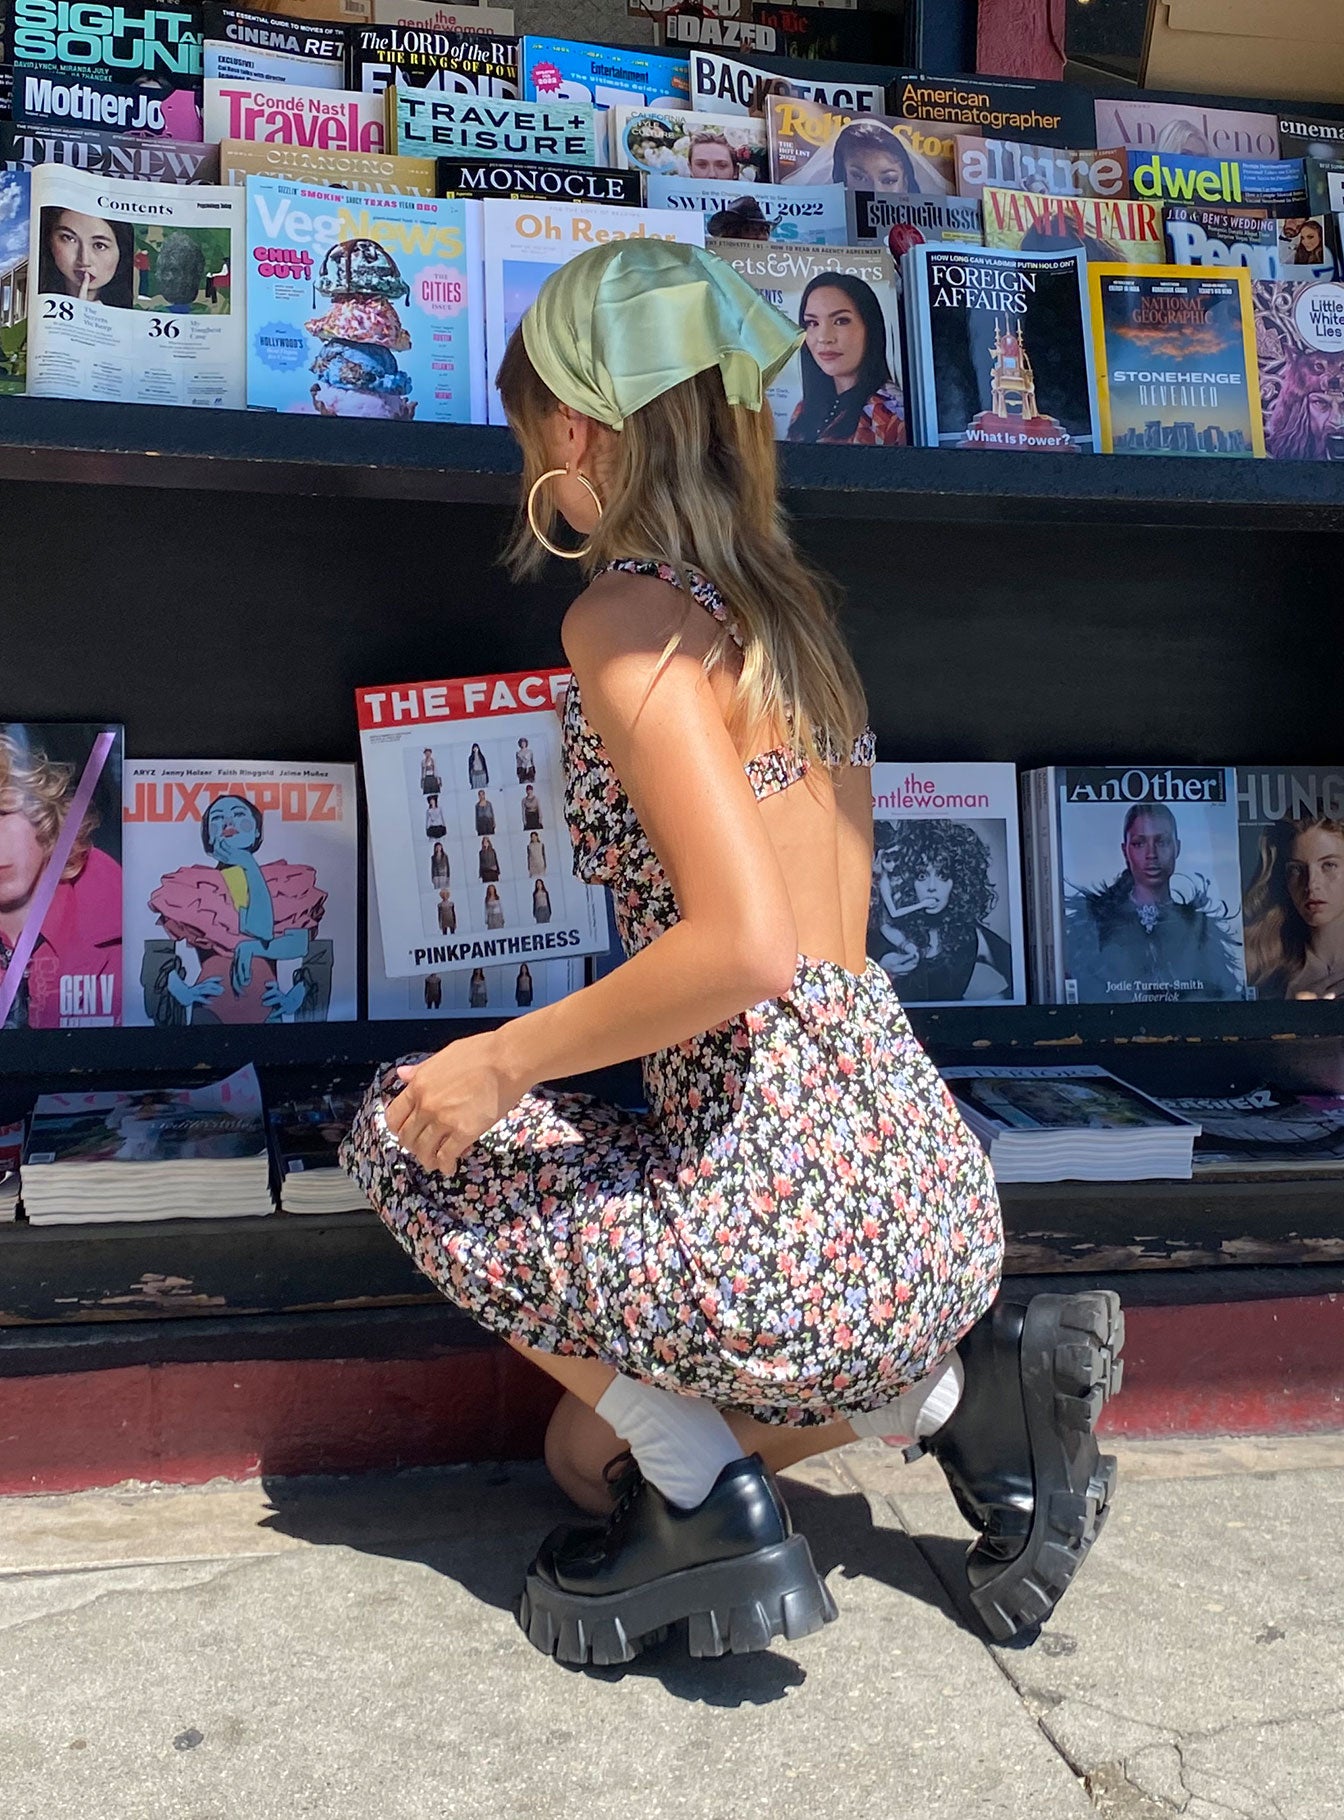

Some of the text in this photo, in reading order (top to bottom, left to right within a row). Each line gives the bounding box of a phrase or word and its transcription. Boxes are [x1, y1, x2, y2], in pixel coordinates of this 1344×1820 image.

[14, 0, 192, 42] SIGHT
[223, 9, 235, 17] THE
[236, 12, 269, 24] ESSENTIAL
[270, 18, 290, 28] GUIDE
[290, 22, 300, 30] TO
[300, 25, 324, 34] MOVIES
[435, 10, 456, 25] the
[678, 15, 776, 52] DAZED
[360, 32, 389, 50] The
[391, 29, 450, 56] LORD
[451, 43, 468, 62] of
[468, 44, 490, 62] the
[377, 50, 405, 64] THE
[410, 53, 458, 70] RINGS
[463, 60, 479, 73] OF
[591, 61, 649, 84] Entertainment
[25, 76, 133, 126] Mother
[253, 92, 346, 117] Condé Nast
[902, 84, 990, 107] American
[631, 111, 687, 123] CALIFORNIA
[902, 100, 1061, 131] Cinematographer
[404, 122, 586, 155] LEISURE
[13, 136, 104, 170] THE
[108, 146, 206, 177] NEW
[962, 139, 1123, 195] allure
[459, 167, 625, 199] MONOCLE
[1134, 155, 1242, 202] dwell
[97, 196, 174, 216] Contents
[363, 199, 397, 208] TEXAS
[415, 203, 438, 212] BBQ
[778, 202, 824, 217] 2022
[991, 191, 1161, 242] VANITY FAIR
[515, 214, 562, 240] Oh
[1202, 212, 1228, 226] BEN'S
[1230, 216, 1274, 231] WEDDING
[253, 246, 314, 266] CHILL
[931, 254, 949, 262] HOW
[950, 256, 969, 264] LONG
[985, 258, 1017, 268] VLADIMIR
[1017, 261, 1038, 269] PUTIN
[1039, 261, 1058, 269] HOLD
[1059, 259, 1075, 268] ON?
[258, 262, 312, 281] OUT!
[932, 266, 1037, 293] FOREIGN
[422, 281, 461, 303] CITIES
[932, 288, 1028, 313] AFFAIRS
[43, 299, 74, 321] 28
[1141, 297, 1205, 311] NATIONAL
[1311, 300, 1344, 312] Little
[148, 318, 180, 338] 36
[1132, 309, 1213, 325] GEOGRAPHIC
[1310, 311, 1344, 325] White
[1316, 325, 1342, 337] Lies
[1113, 371, 1241, 384] STONEHENGE
[1139, 385, 1218, 407] REVEALED
[966, 429, 1070, 446] What Is Power?
[364, 686, 450, 723] THE
[161, 769, 185, 778] Jenny
[239, 769, 274, 778] Ringgold
[279, 769, 302, 777] Jaime
[904, 773, 935, 794] the
[1069, 770, 1219, 801] AnOther
[122, 782, 337, 823] JUXTAPOZ
[60, 974, 96, 1016] GEN
[100, 974, 114, 1015] V
[1106, 980, 1204, 993] Jodie Turner-Smith
